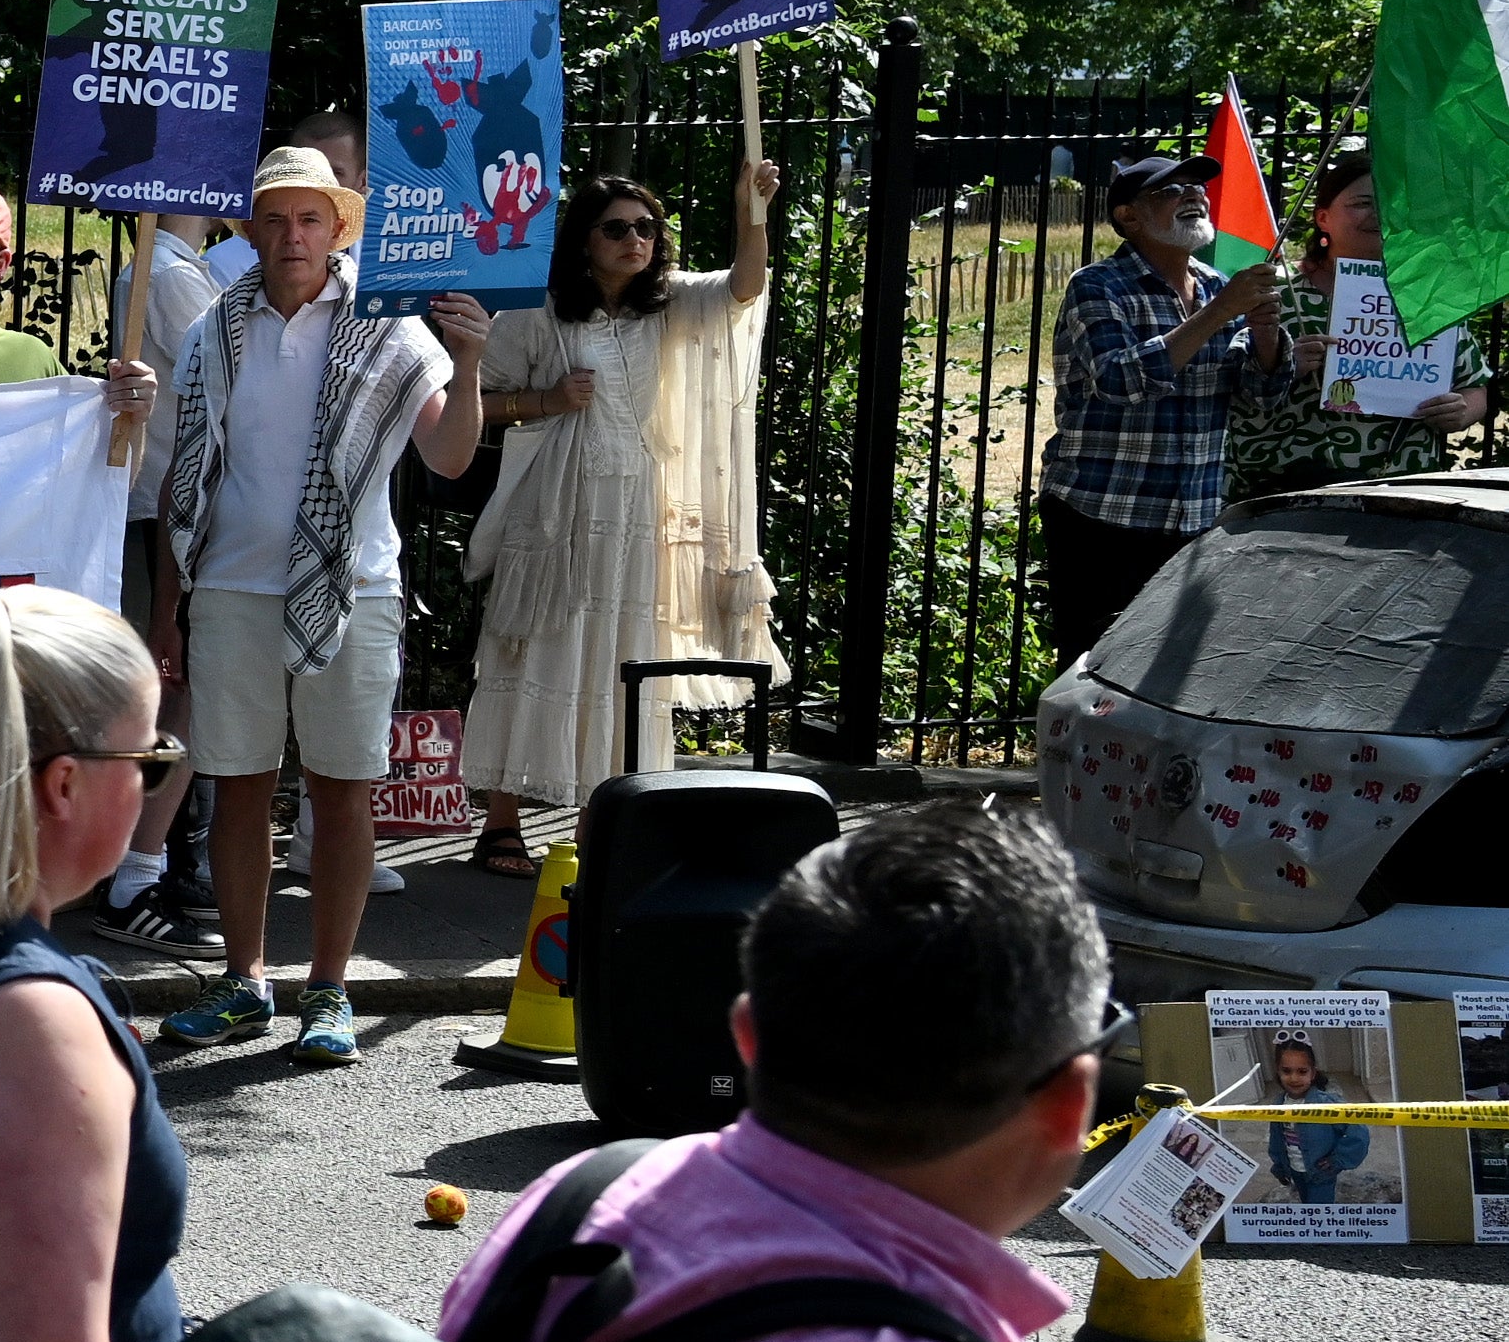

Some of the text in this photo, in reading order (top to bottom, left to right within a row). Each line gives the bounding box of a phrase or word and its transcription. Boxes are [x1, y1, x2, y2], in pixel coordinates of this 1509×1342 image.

[103, 9, 224, 44] SERVES
[383, 18, 443, 33] BARCLAYS
[668, 1, 827, 52] #BoycottBarclays
[385, 37, 470, 50] DON'T BANK ON
[90, 41, 229, 78] ISRAEL'S
[72, 74, 239, 113] GENOCIDE
[38, 172, 243, 212] #BoycottBarclays
[384, 184, 444, 210] Stop
[380, 212, 482, 239] Arming
[378, 234, 453, 263] Israel
[1337, 358, 1440, 384] BARCLAYS
[429, 742, 451, 754] THE
[426, 762, 446, 775] OF
[1213, 997, 1220, 1005] If
[1224, 997, 1252, 1005] there
[1288, 997, 1325, 1005] funeral
[1328, 999, 1358, 1007] every
[1361, 997, 1380, 1007] day
[1210, 1008, 1225, 1016] for
[1228, 1008, 1261, 1016] Gazan
[1263, 1008, 1288, 1016] kids,
[1314, 1008, 1345, 1016] would
[1288, 1019, 1306, 1028] day
[1232, 1206, 1397, 1216] Hind Rajab, age 5, died alone
[1241, 1218, 1389, 1227] surrounded by the lifeless
[1258, 1229, 1373, 1239] bodies of her family.
